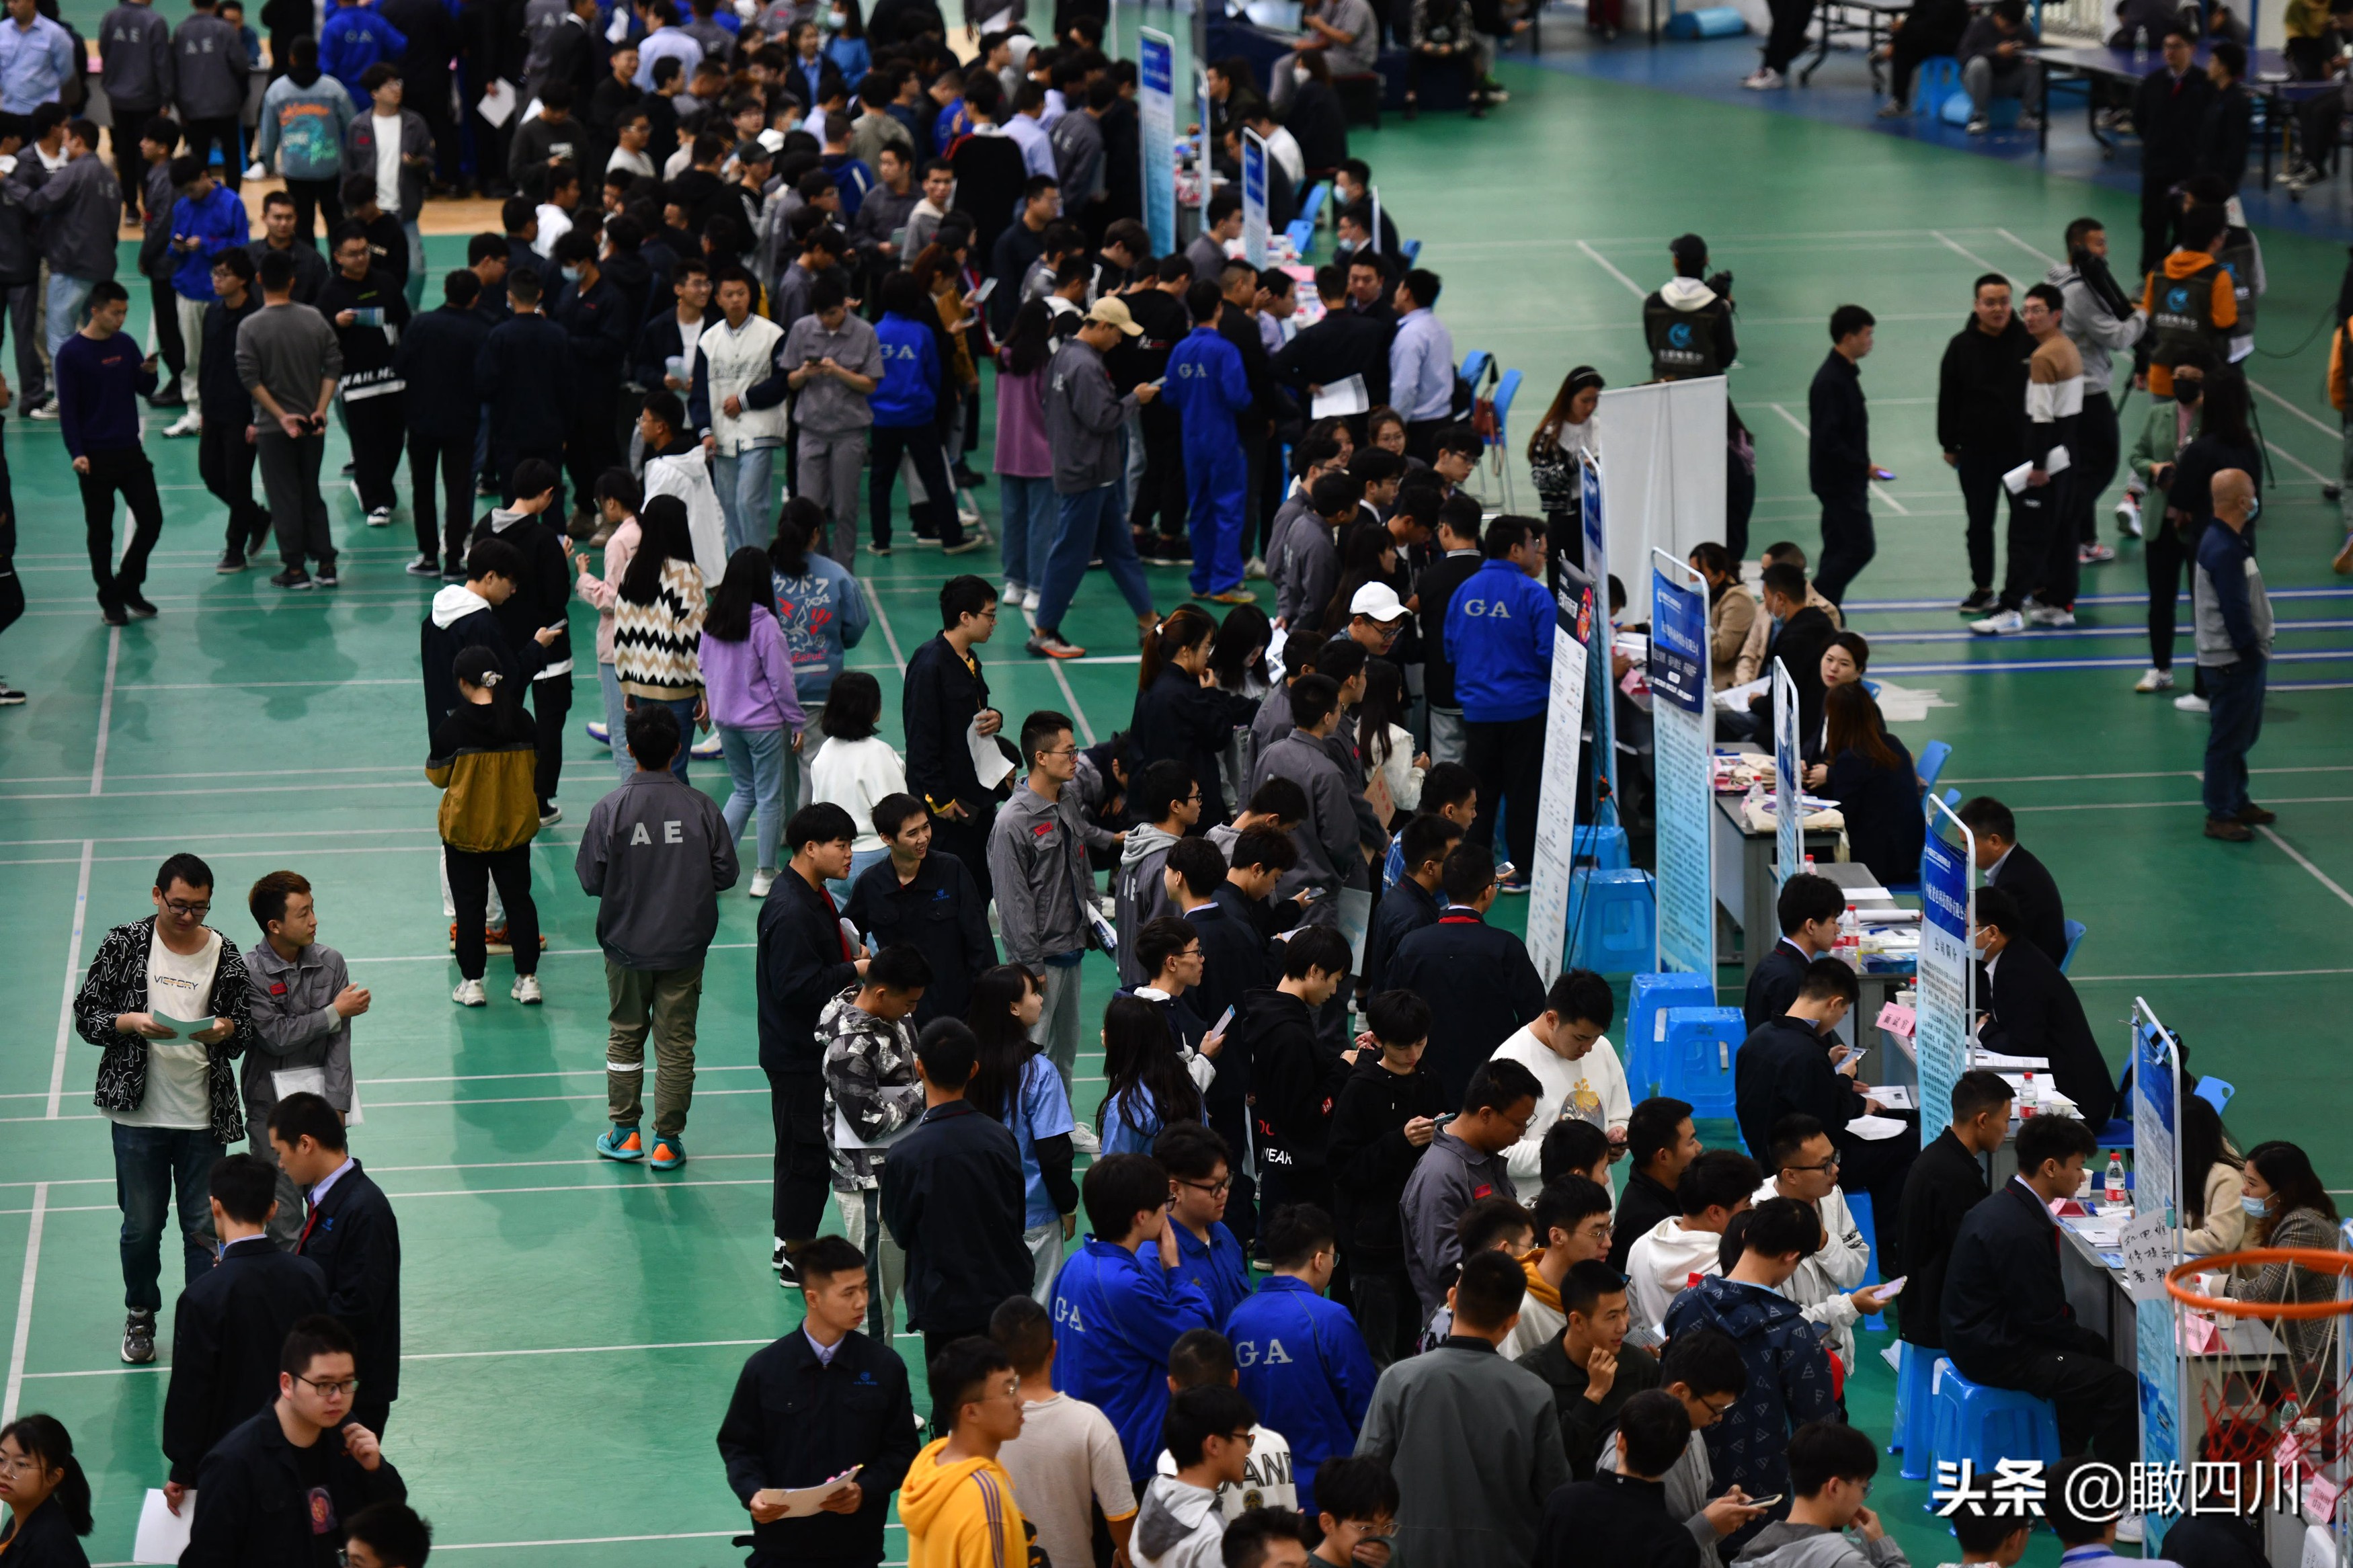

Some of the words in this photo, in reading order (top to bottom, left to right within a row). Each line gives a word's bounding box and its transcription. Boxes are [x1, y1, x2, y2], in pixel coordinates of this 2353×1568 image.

[1178, 362, 1209, 380] GA
[1464, 598, 1512, 619] GA
[154, 975, 199, 991] VICTORY
[1054, 1296, 1086, 1333] GA
[1235, 1338, 1293, 1368] GA
